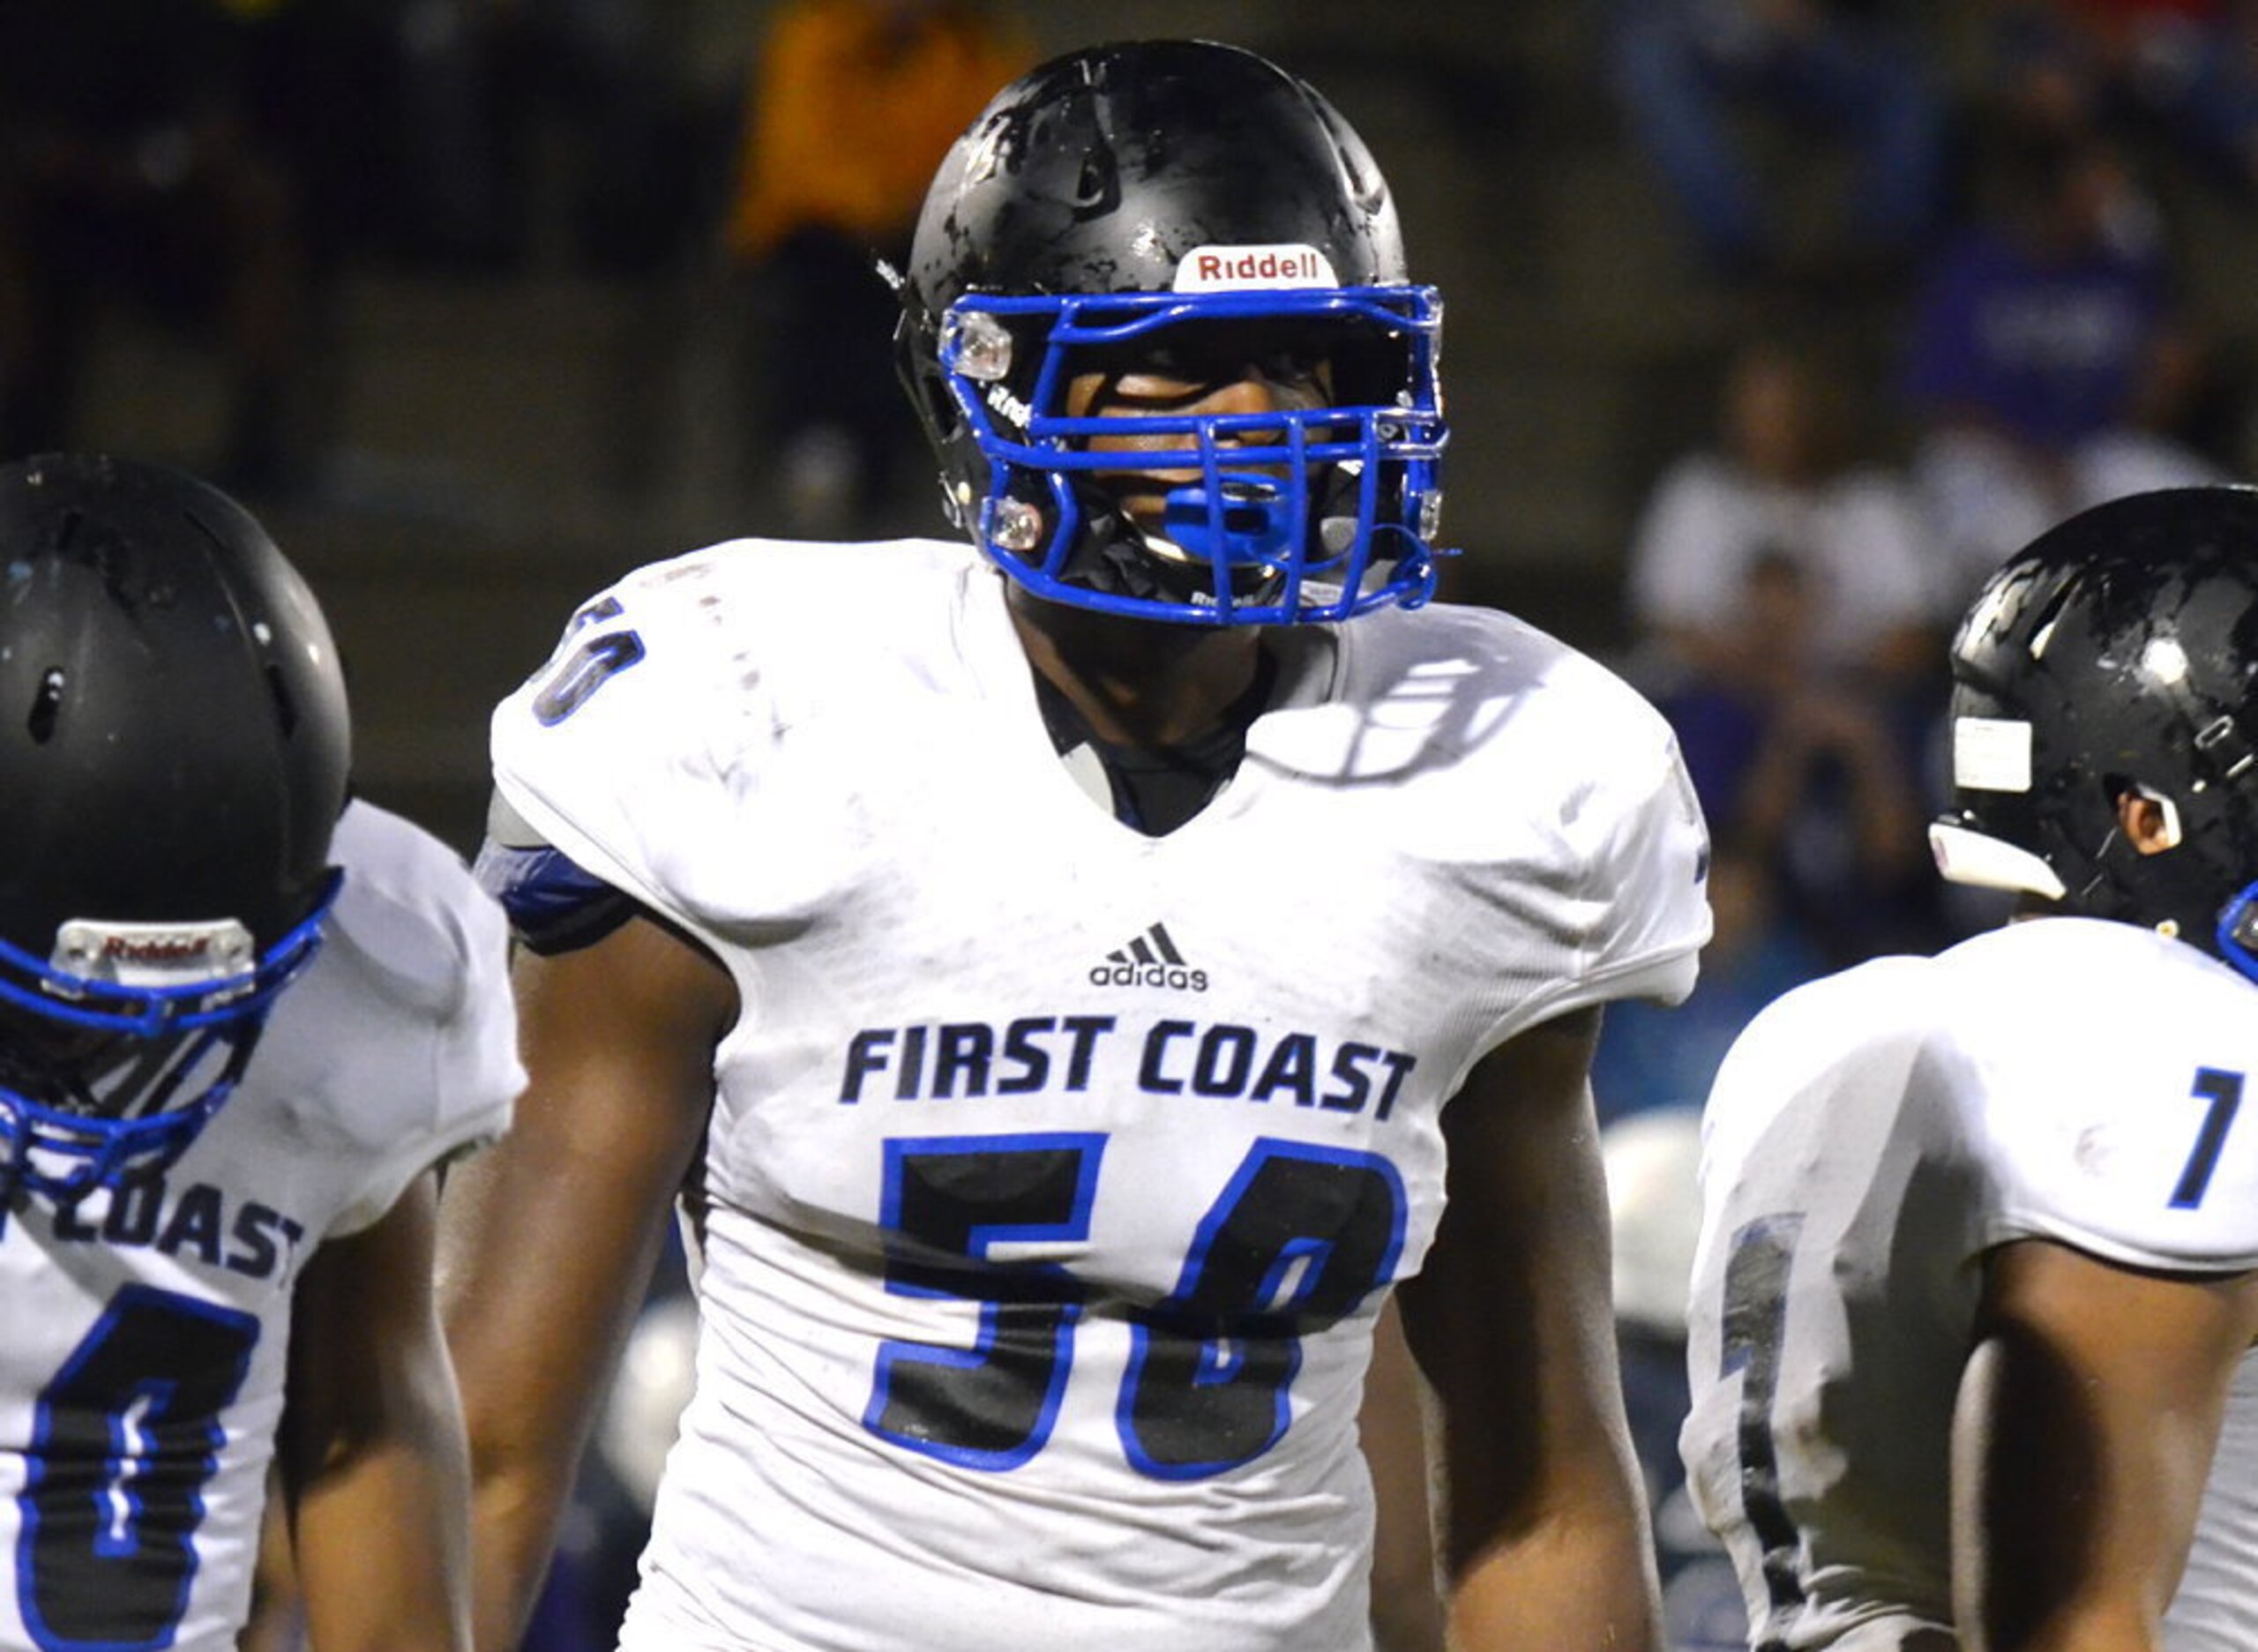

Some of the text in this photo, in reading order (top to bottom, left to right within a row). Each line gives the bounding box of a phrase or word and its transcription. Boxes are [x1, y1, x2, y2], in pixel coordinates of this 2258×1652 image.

[1198, 253, 1318, 281] Riddell
[1191, 591, 1255, 609] Riell
[1089, 962, 1209, 991] adidas
[838, 1015, 1417, 1121] FIRST COAST
[861, 1132, 1409, 1483] 50
